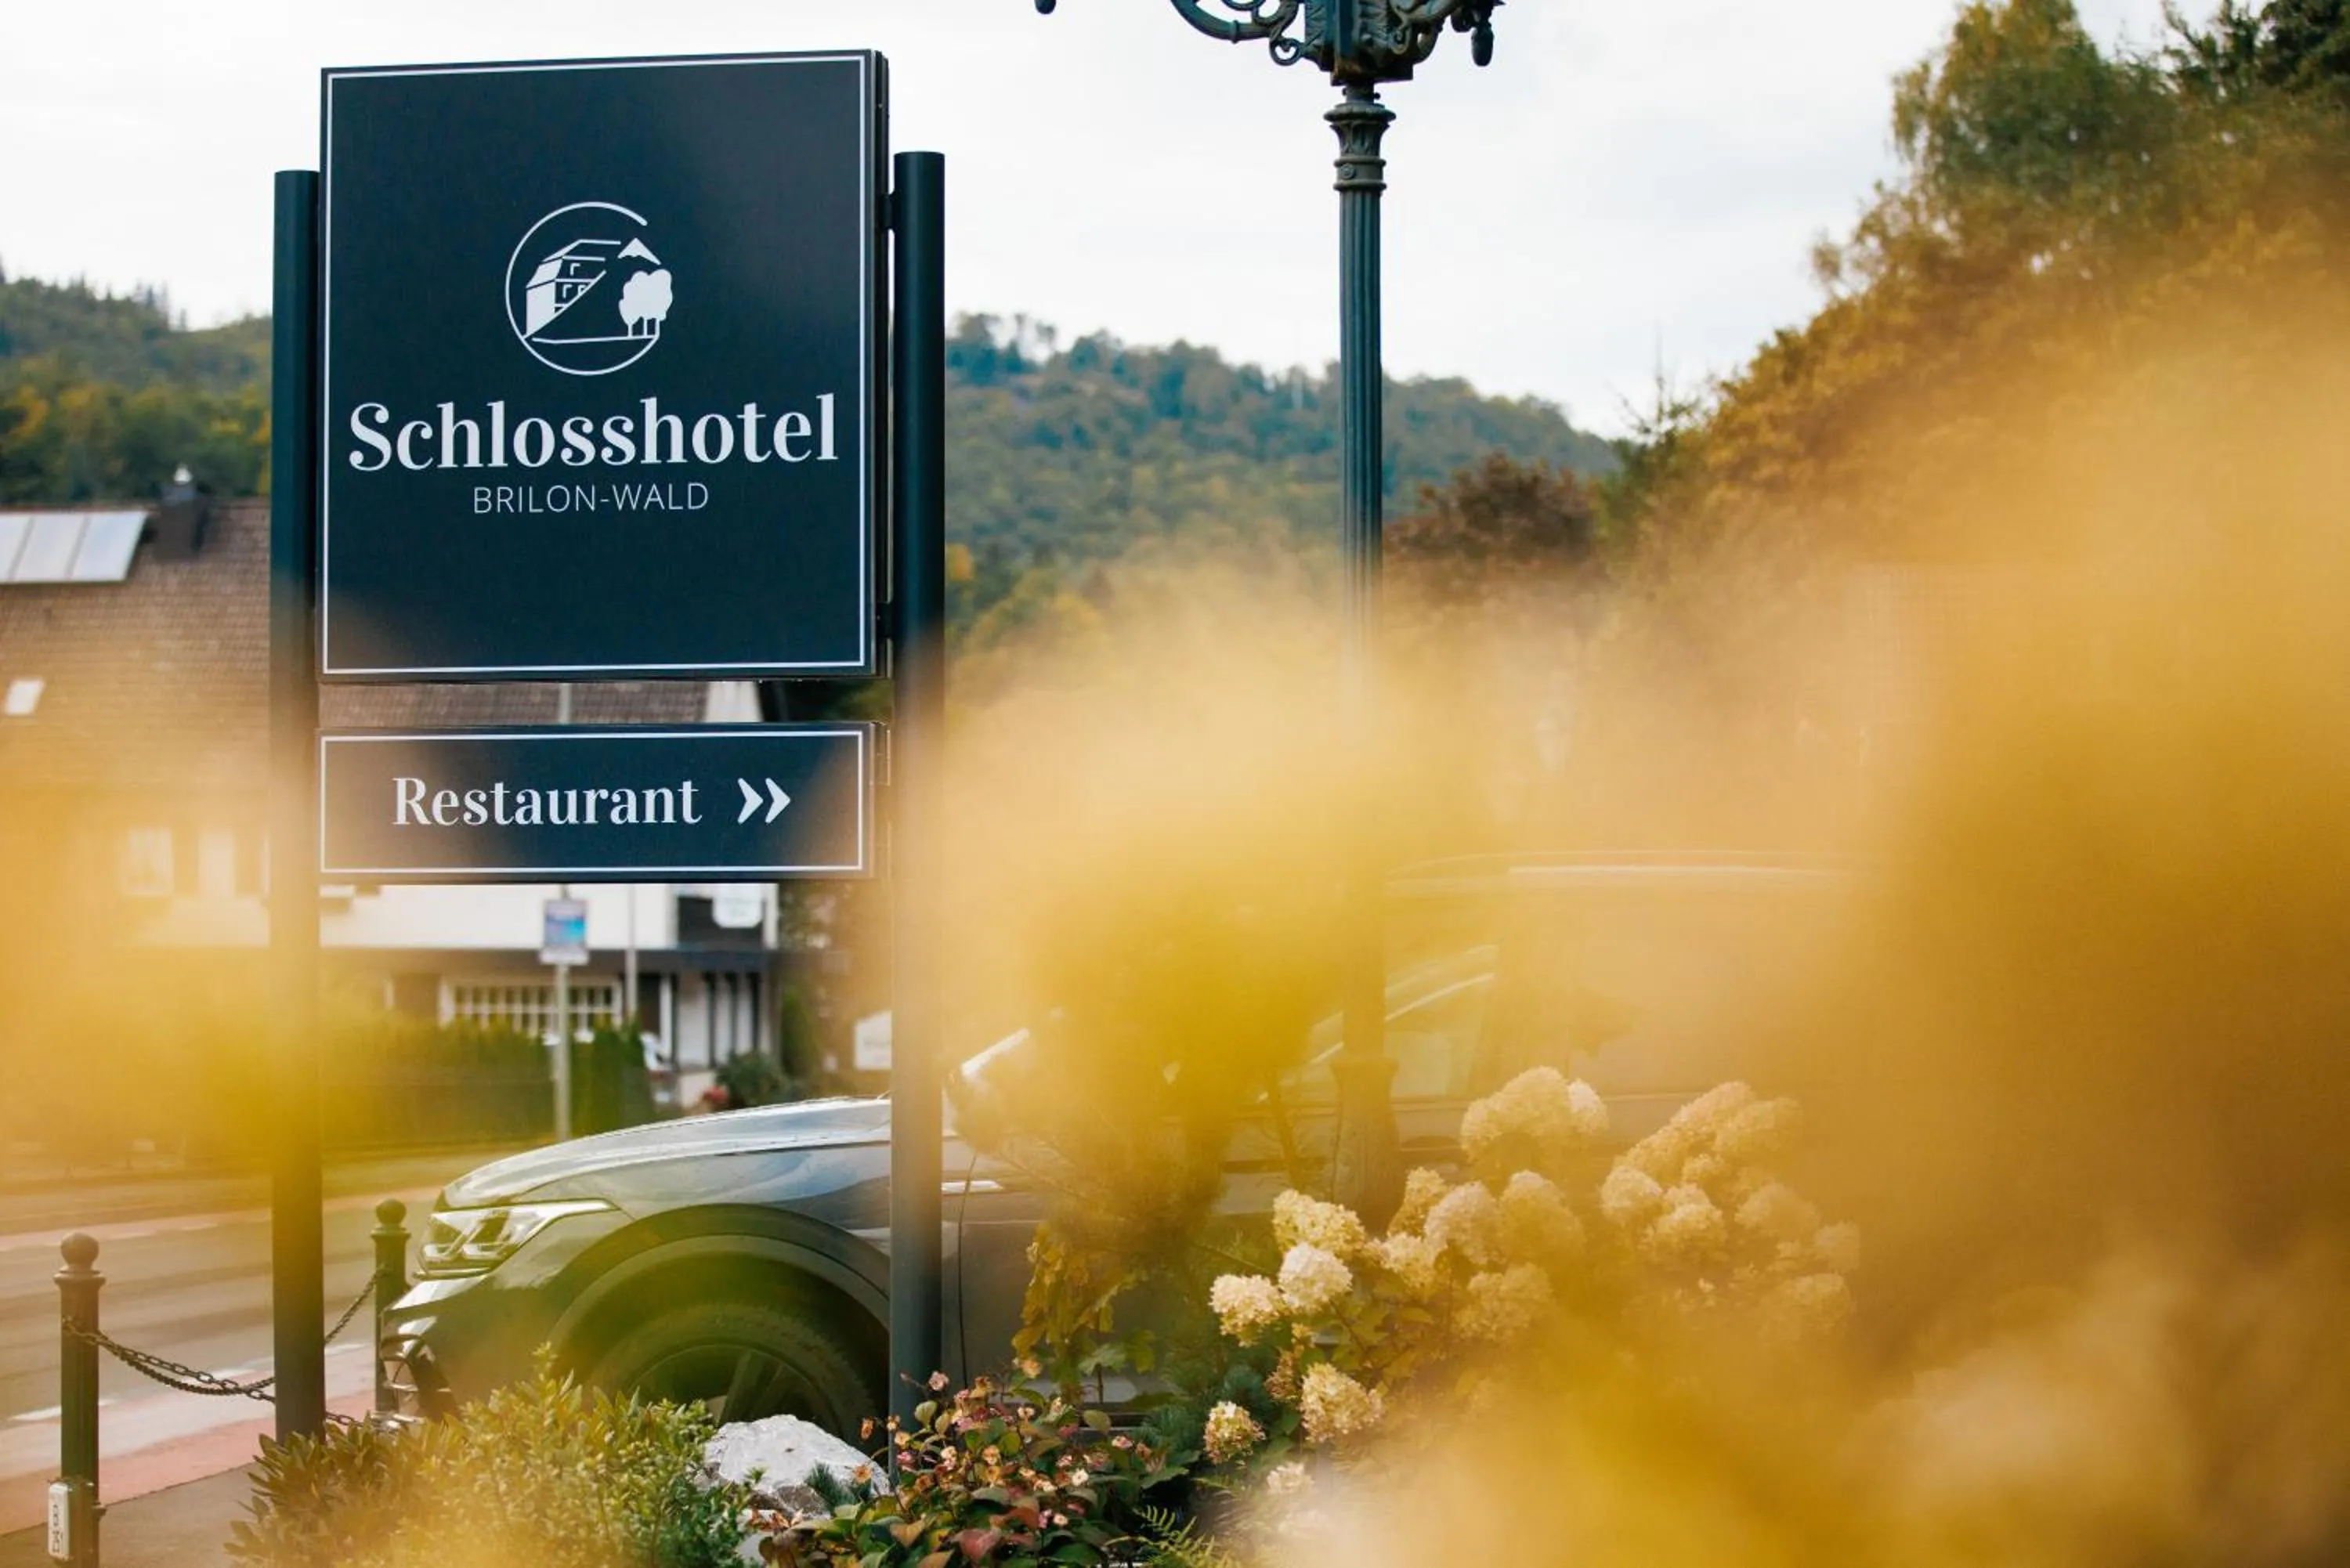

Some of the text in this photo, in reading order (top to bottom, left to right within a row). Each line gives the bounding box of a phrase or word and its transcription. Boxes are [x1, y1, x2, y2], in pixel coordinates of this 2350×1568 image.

[349, 392, 838, 471] Schlosshotel
[473, 482, 709, 514] BRILON-WALD
[392, 776, 703, 826] Restaurant
